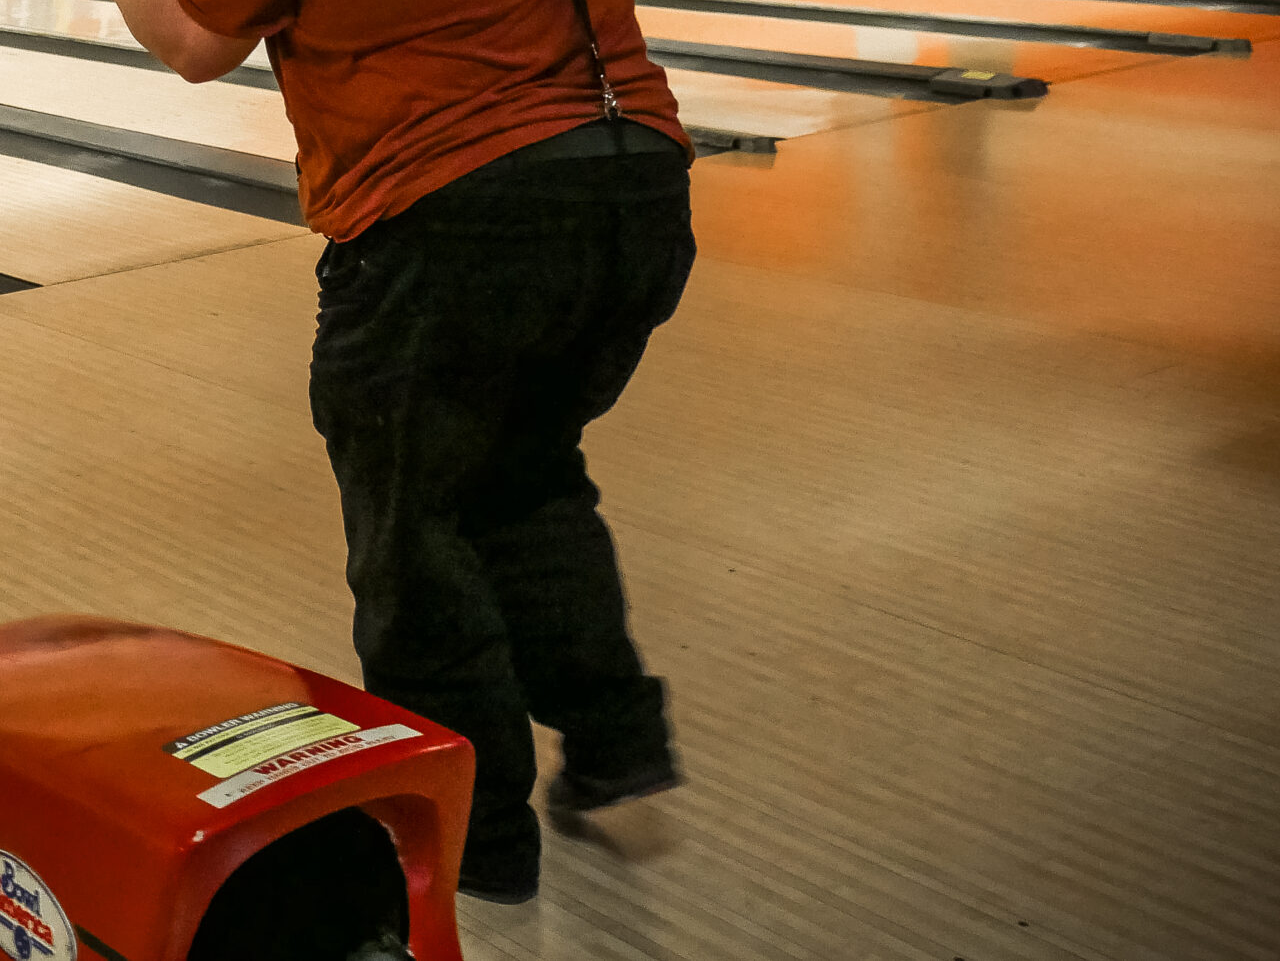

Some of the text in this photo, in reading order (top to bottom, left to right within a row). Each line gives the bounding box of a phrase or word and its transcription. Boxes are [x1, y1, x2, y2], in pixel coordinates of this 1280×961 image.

[186, 718, 243, 743] BOWLER
[253, 735, 366, 776] WARNING
[1, 859, 43, 919] Bowl
